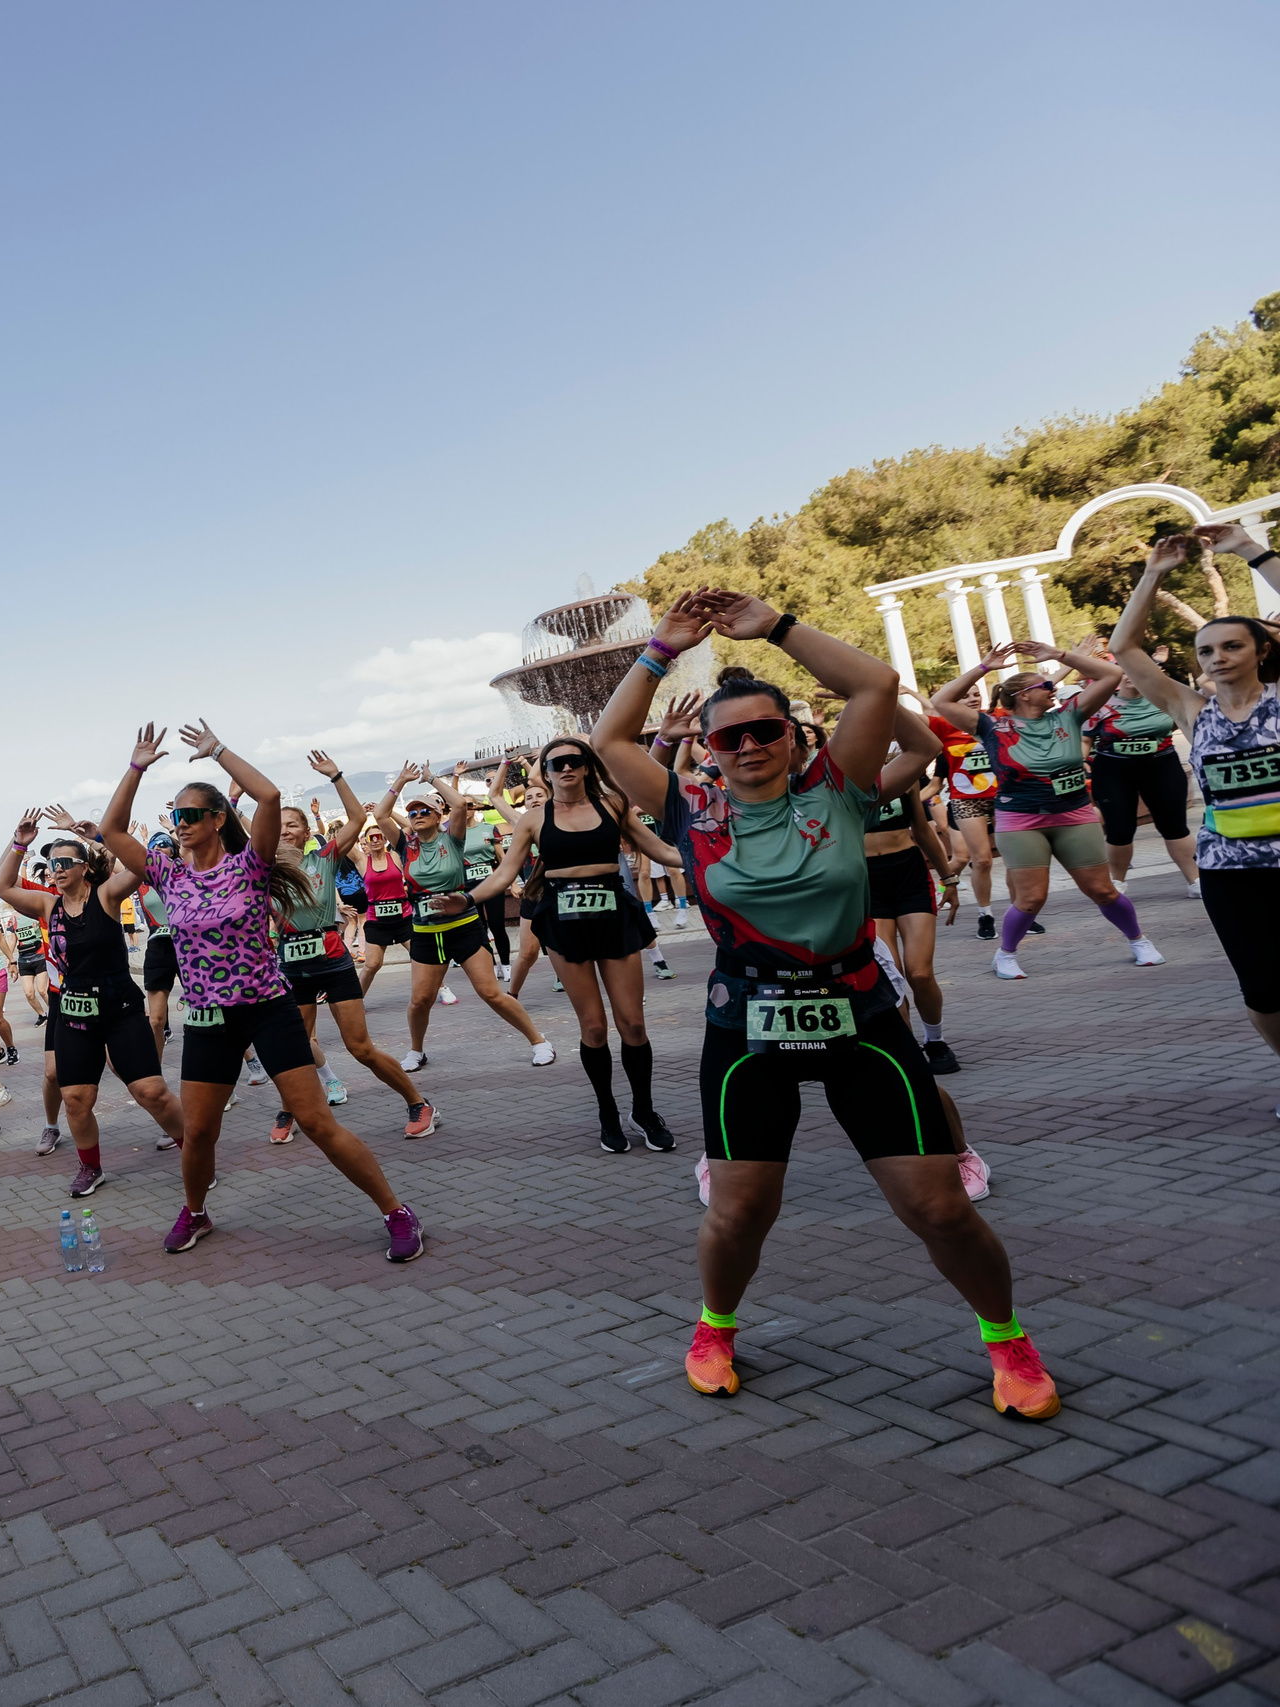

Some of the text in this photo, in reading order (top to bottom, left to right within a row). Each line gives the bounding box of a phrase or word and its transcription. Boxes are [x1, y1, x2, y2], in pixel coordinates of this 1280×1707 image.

[1120, 742, 1151, 752] 7136
[1216, 758, 1280, 784] 7353
[470, 867, 489, 877] 7156
[566, 893, 607, 908] 7277
[378, 905, 399, 914] 7324
[289, 942, 317, 957] 7127
[64, 999, 92, 1013] 7078
[759, 1004, 841, 1032] 7168
[779, 1042, 827, 1050] СВЕТЛАНА
